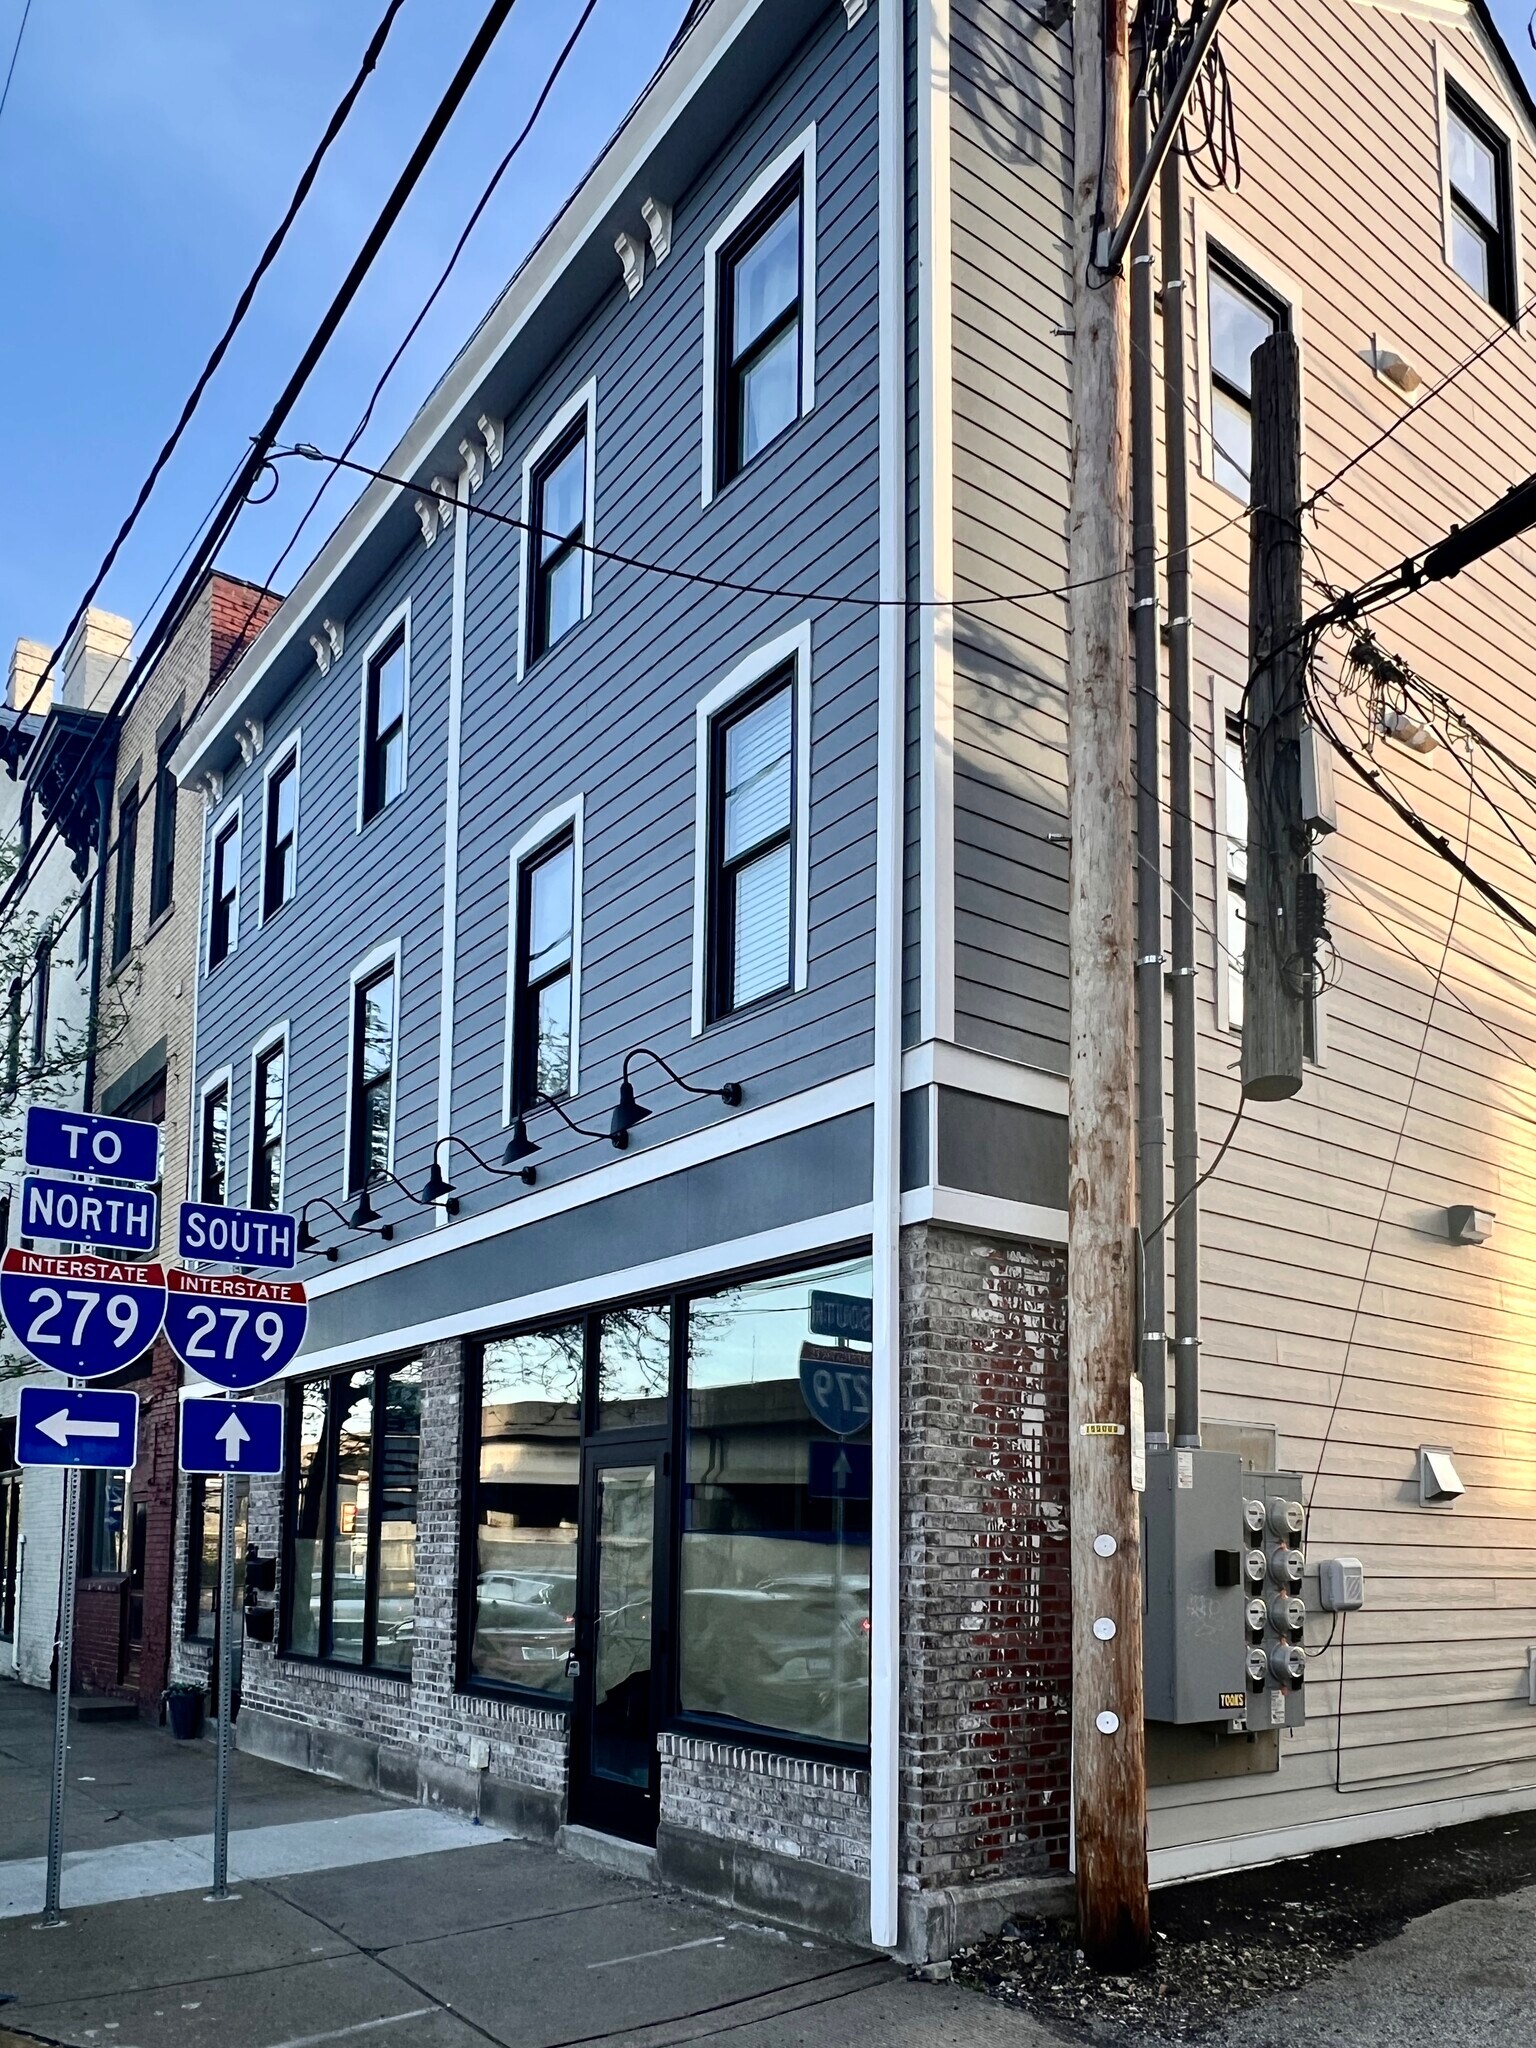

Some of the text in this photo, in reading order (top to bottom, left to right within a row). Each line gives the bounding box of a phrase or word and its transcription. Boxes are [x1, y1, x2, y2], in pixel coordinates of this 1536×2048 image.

[61, 1124, 122, 1164] TO
[29, 1186, 148, 1237] NORTH
[186, 1212, 290, 1257] SOUTH
[21, 1256, 148, 1283] INTERSTATE
[180, 1275, 292, 1301] INTERSTATE
[27, 1287, 139, 1349] 279
[185, 1305, 284, 1362] 279
